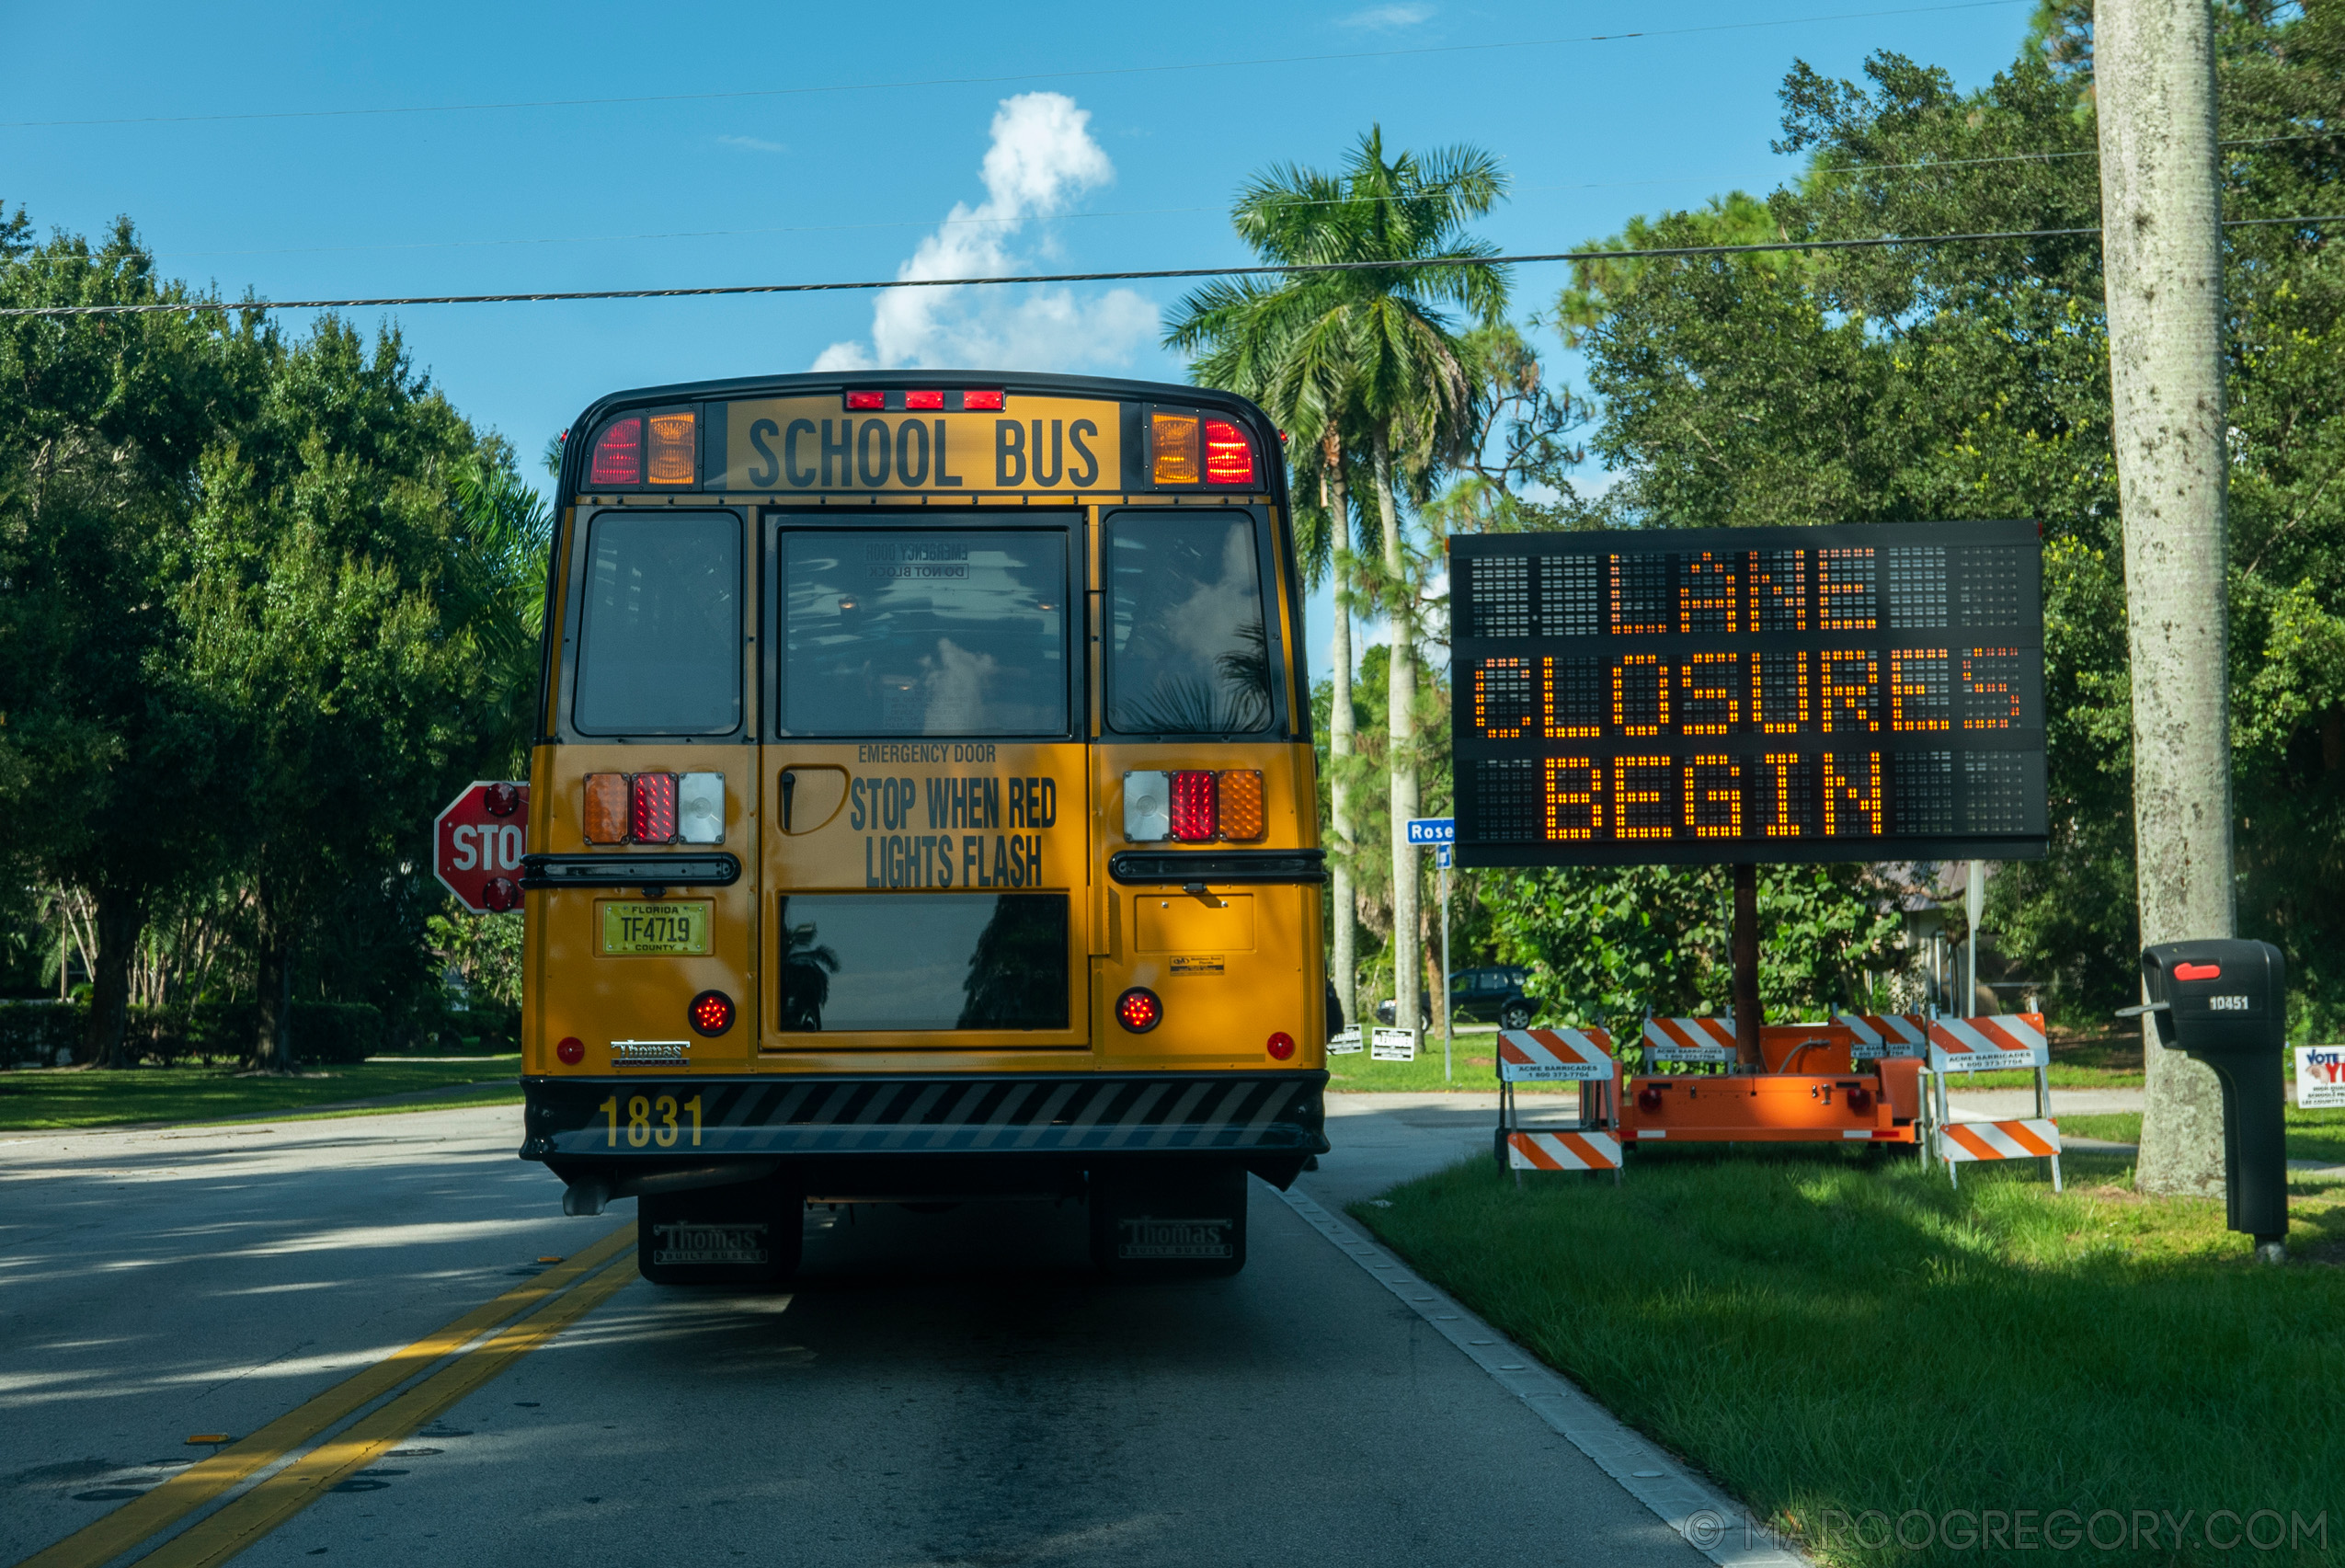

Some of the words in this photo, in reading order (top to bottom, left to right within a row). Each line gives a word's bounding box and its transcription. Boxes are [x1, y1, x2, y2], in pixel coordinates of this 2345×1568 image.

[748, 418, 963, 488] SCHOOL
[995, 418, 1099, 488] BUS
[1609, 548, 1877, 635] LANE
[1474, 646, 2020, 738] CLOSURES
[858, 744, 949, 763] EMERGENCY
[954, 744, 996, 763] DOOR
[850, 777, 916, 831] STOP
[925, 777, 1000, 830] WHEN
[1008, 777, 1057, 829] RED
[1545, 750, 1882, 841] BEGIN
[452, 824, 529, 871] STO
[865, 835, 954, 889] LIGHTS
[962, 834, 1042, 888] FLASH
[632, 906, 679, 914] FLORIDA
[621, 917, 690, 943] TF4719
[2209, 995, 2249, 1011] 10451
[611, 1039, 691, 1059] Thomas
[1975, 1052, 2031, 1060] BARRICADES
[2306, 1048, 2339, 1064] VOTE
[2325, 1063, 2345, 1083] Y
[600, 1094, 702, 1148] 1831
[654, 1220, 767, 1251] Thomas
[1119, 1215, 1232, 1244] Thomas
